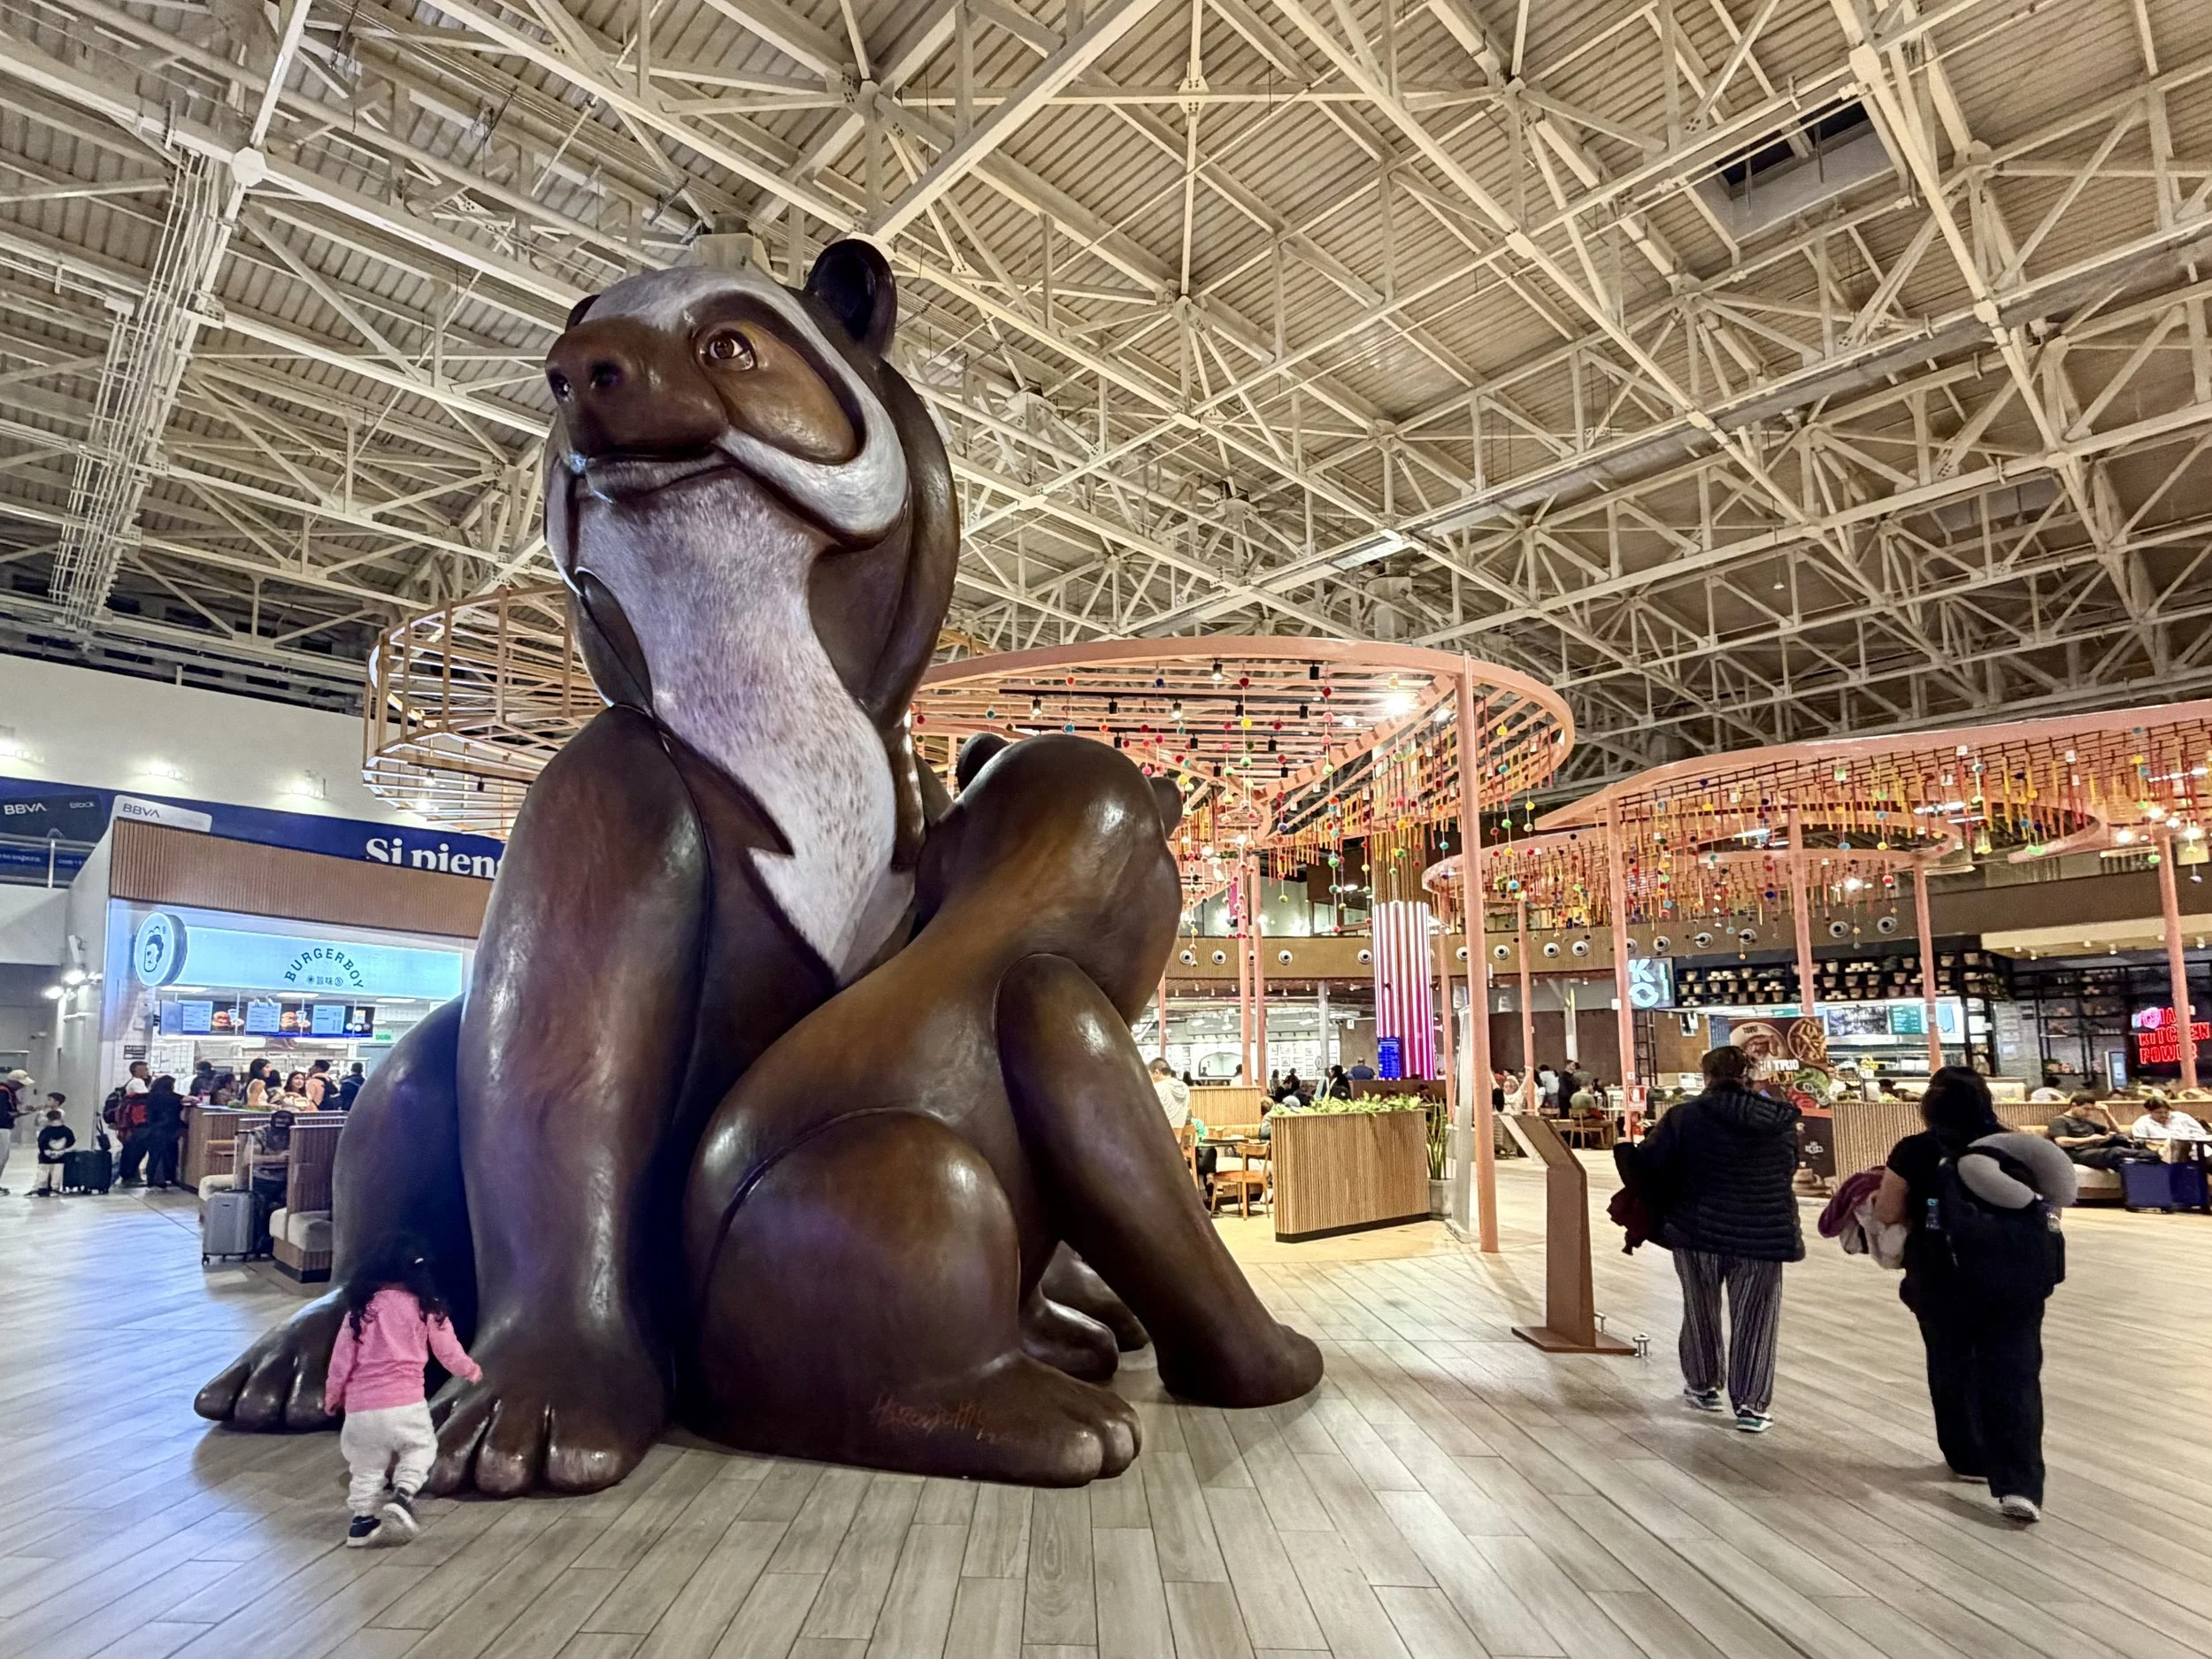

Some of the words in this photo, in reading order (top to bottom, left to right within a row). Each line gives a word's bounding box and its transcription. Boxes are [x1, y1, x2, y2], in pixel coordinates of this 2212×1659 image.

[4, 803, 47, 816] BBVA
[122, 803, 160, 818] BBVA
[365, 837, 403, 864] Si
[411, 842, 503, 879] pien
[284, 948, 365, 987] BURGERBOY
[2138, 1022, 2210, 1047] KITCEN
